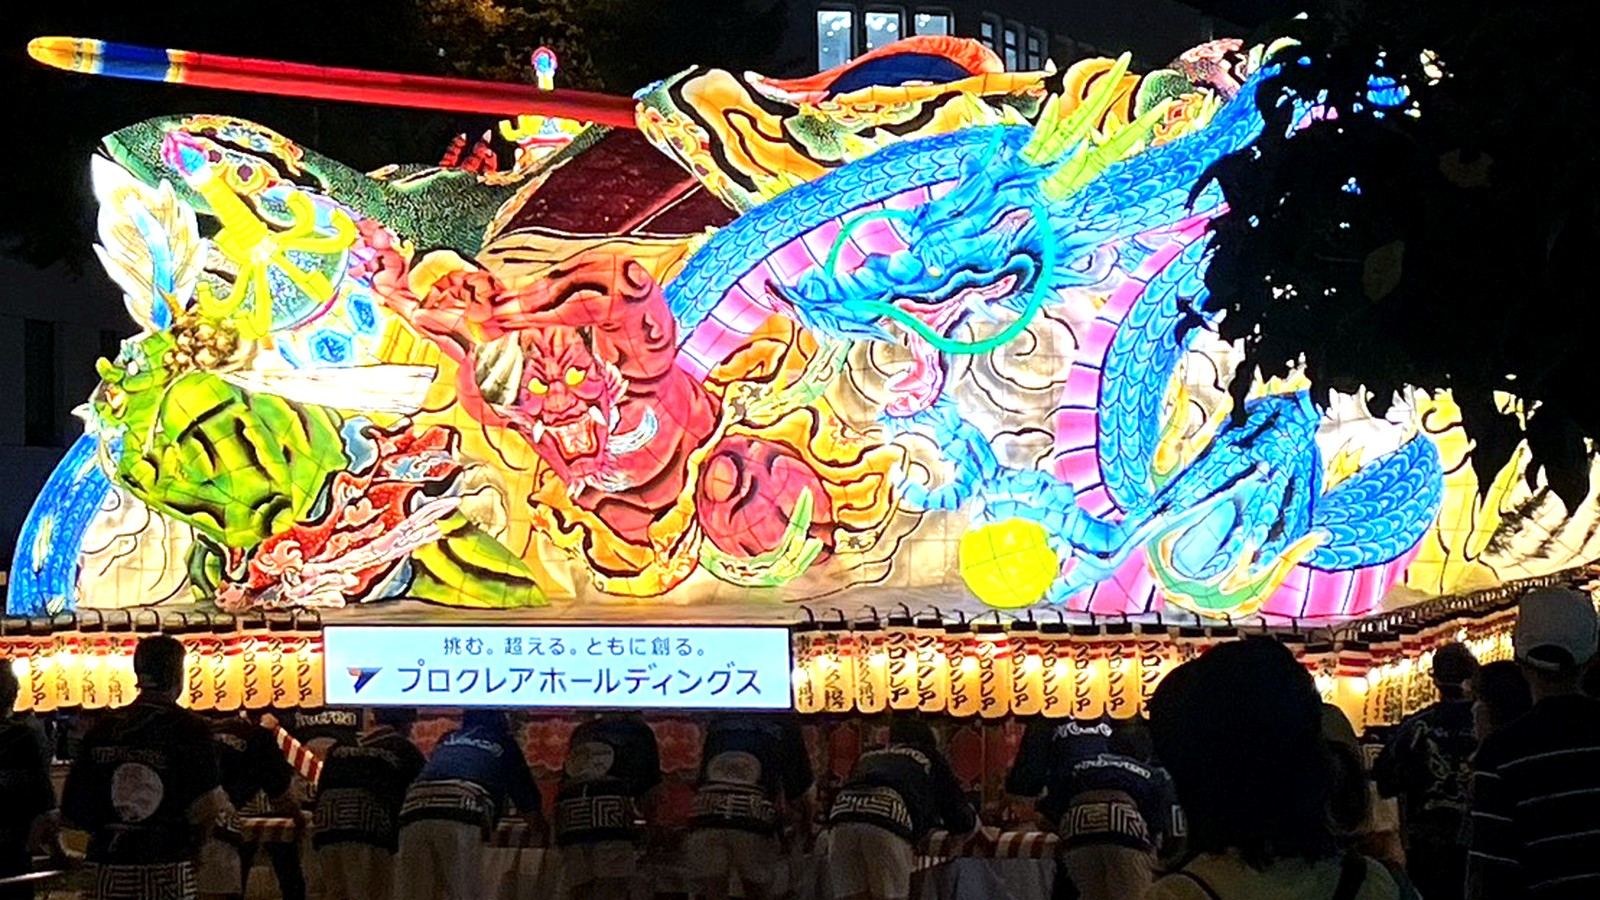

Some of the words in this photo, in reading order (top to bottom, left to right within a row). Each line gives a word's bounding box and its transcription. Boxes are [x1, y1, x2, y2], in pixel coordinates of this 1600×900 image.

[443, 636, 706, 657] 挑む。超える。ともに創る。
[397, 658, 763, 696] プロクレアホールディングス
